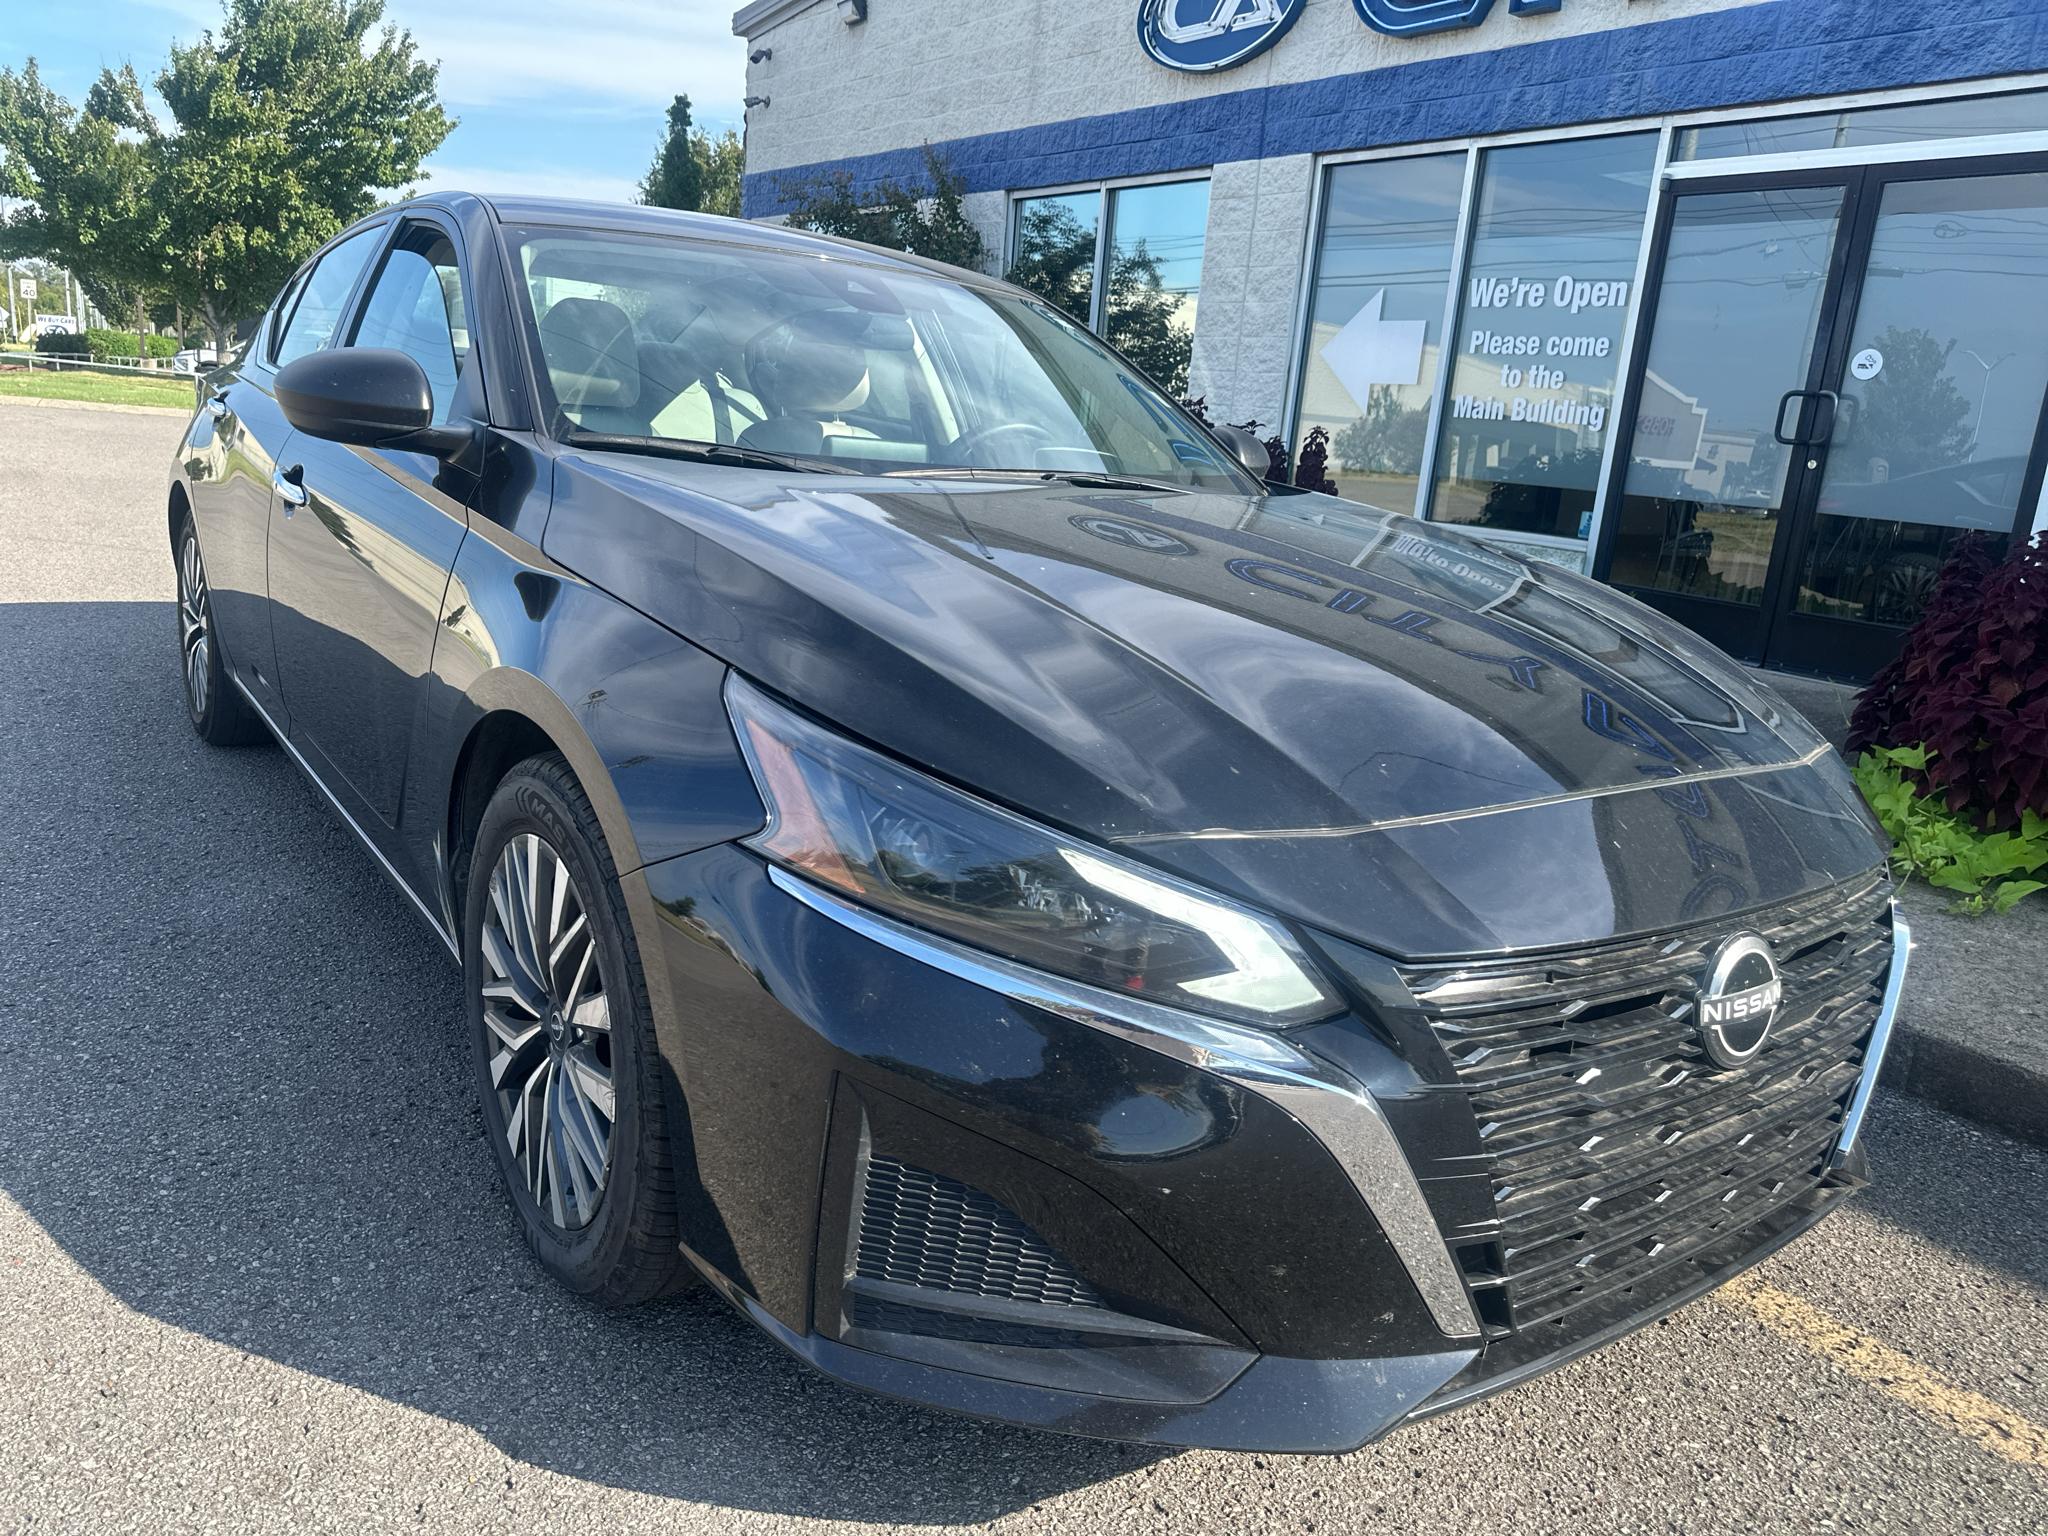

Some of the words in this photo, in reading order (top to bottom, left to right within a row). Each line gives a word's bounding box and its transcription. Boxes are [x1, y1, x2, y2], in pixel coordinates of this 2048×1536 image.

[23, 289, 36, 297] 40
[1470, 276, 1546, 308] We're
[1553, 275, 1628, 314] Open
[1469, 330, 1541, 356] Please
[1546, 336, 1611, 358] come
[1500, 364, 1523, 389] to
[1528, 364, 1565, 390] the
[1453, 395, 1506, 419] Main
[1510, 396, 1607, 433] Building
[1702, 983, 1781, 1023] NISSAN
